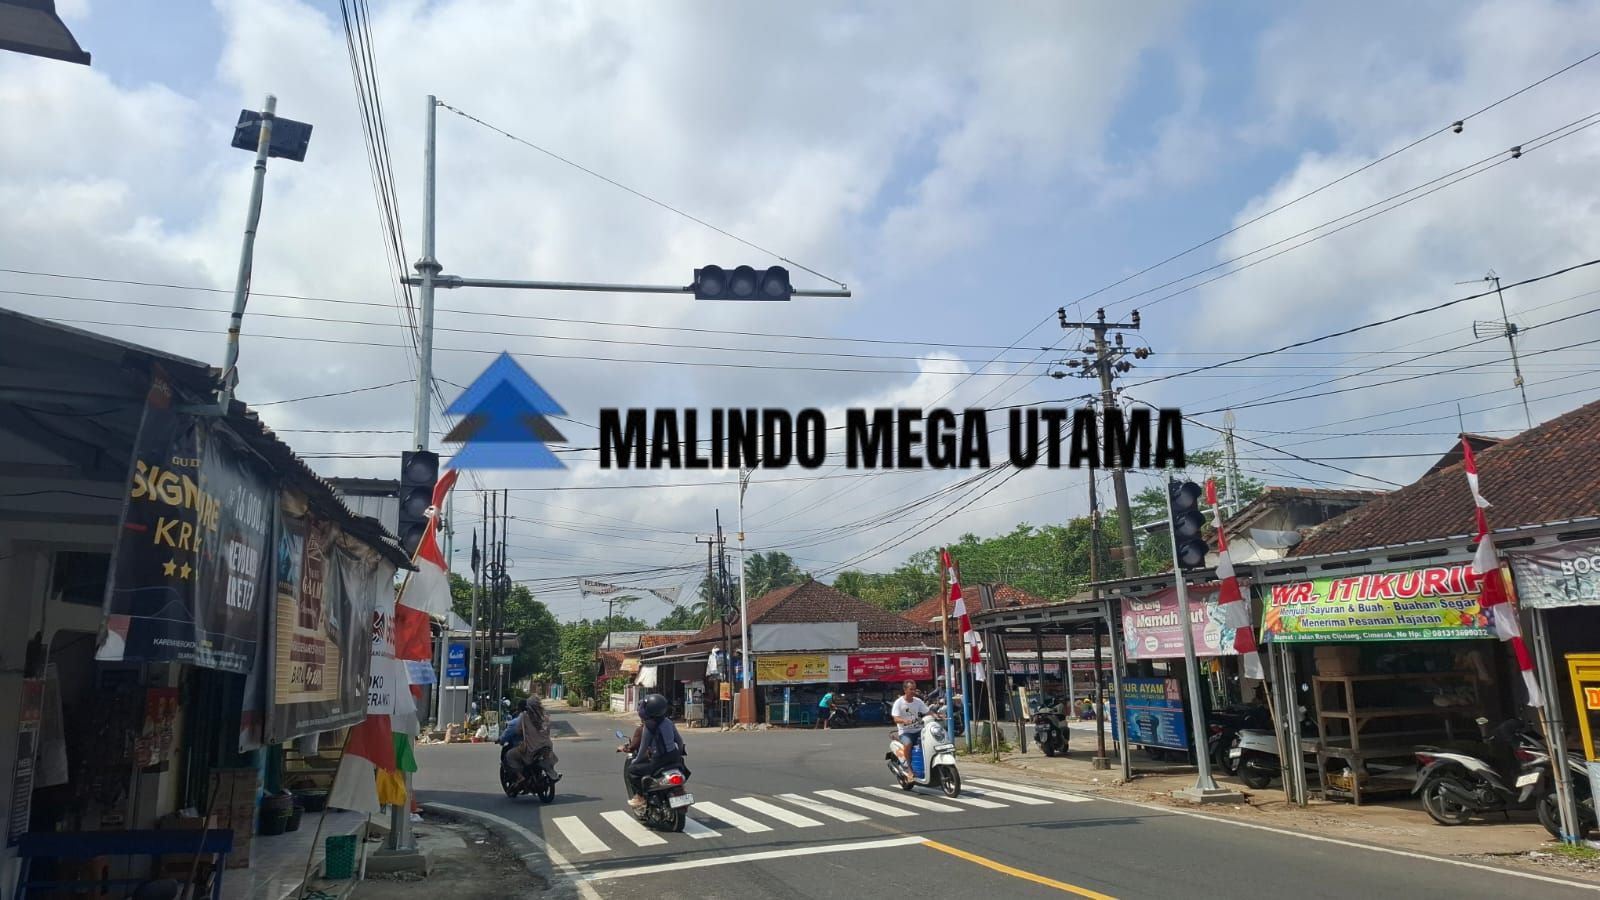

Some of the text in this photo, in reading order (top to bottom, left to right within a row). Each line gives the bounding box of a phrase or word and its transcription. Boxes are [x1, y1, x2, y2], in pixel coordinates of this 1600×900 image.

[1271, 581, 1320, 607] WR.
[1280, 608, 1307, 616] Menjual
[1310, 605, 1345, 615] Sayuran
[1348, 604, 1355, 612] &
[1358, 602, 1384, 613] Buah
[1394, 601, 1437, 611] Buahan
[1440, 598, 1476, 610] Segar
[1136, 609, 1204, 628] Mamah ut
[1301, 614, 1442, 627] Menerima Pesanan Hajatan
[1140, 683, 1163, 694] AYAM
